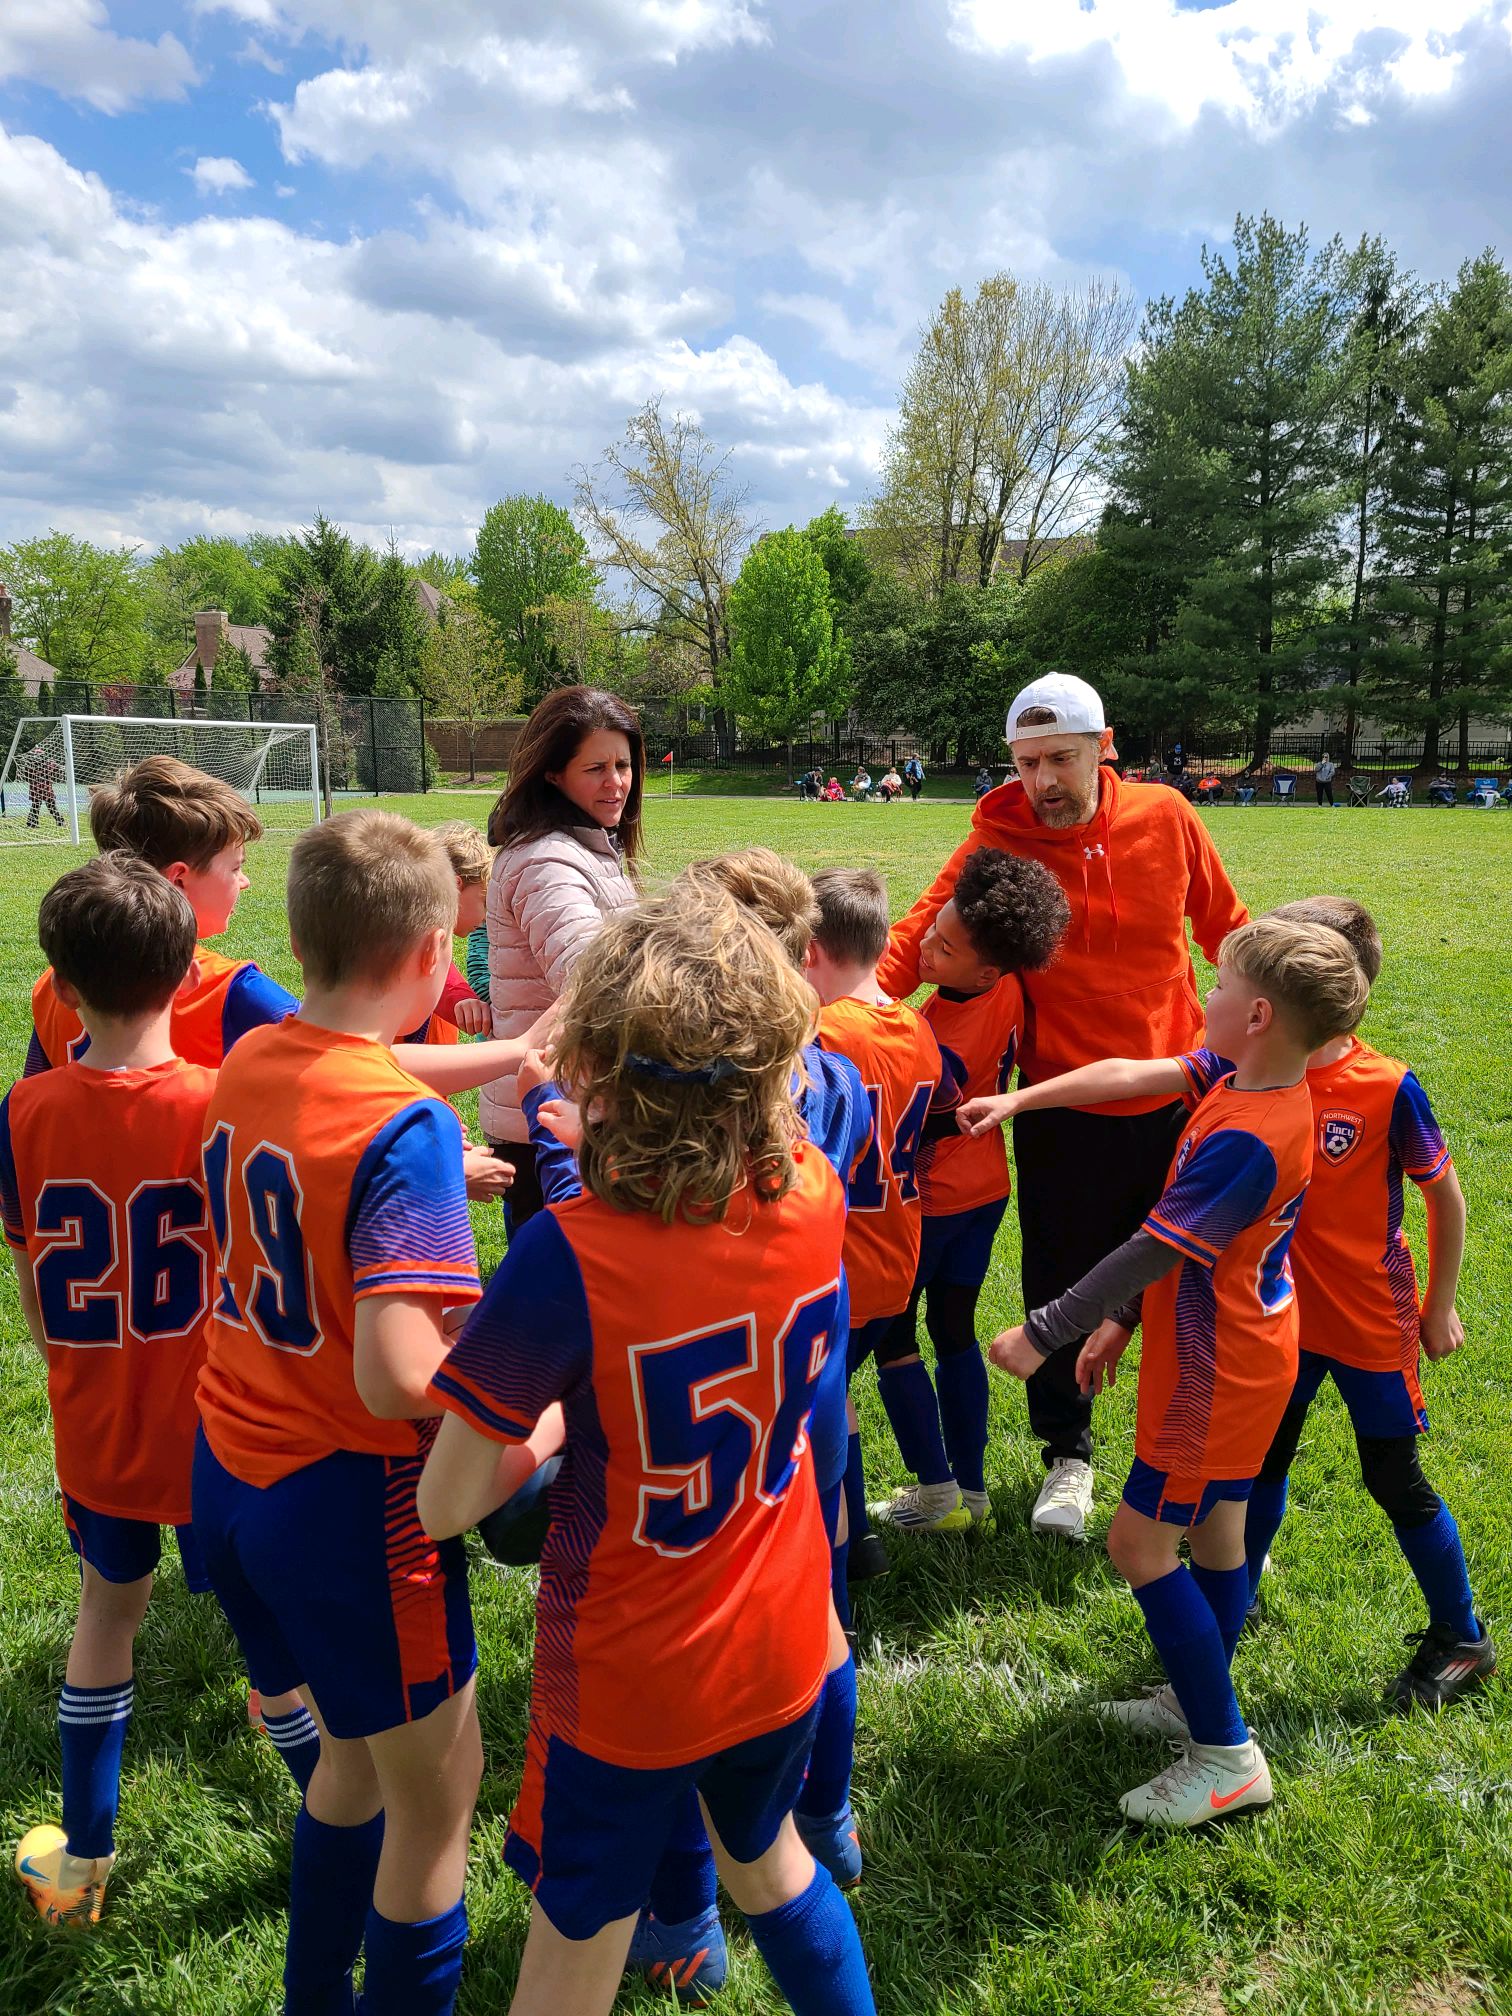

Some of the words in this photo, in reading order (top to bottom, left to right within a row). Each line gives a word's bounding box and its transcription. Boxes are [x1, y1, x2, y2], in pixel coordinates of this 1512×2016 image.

[848, 1080, 935, 1212] 14
[1323, 1112, 1363, 1125] NORTHWEST
[1326, 1122, 1355, 1139] Cincy
[33, 1177, 208, 1349] 26
[202, 1119, 325, 1357] 19
